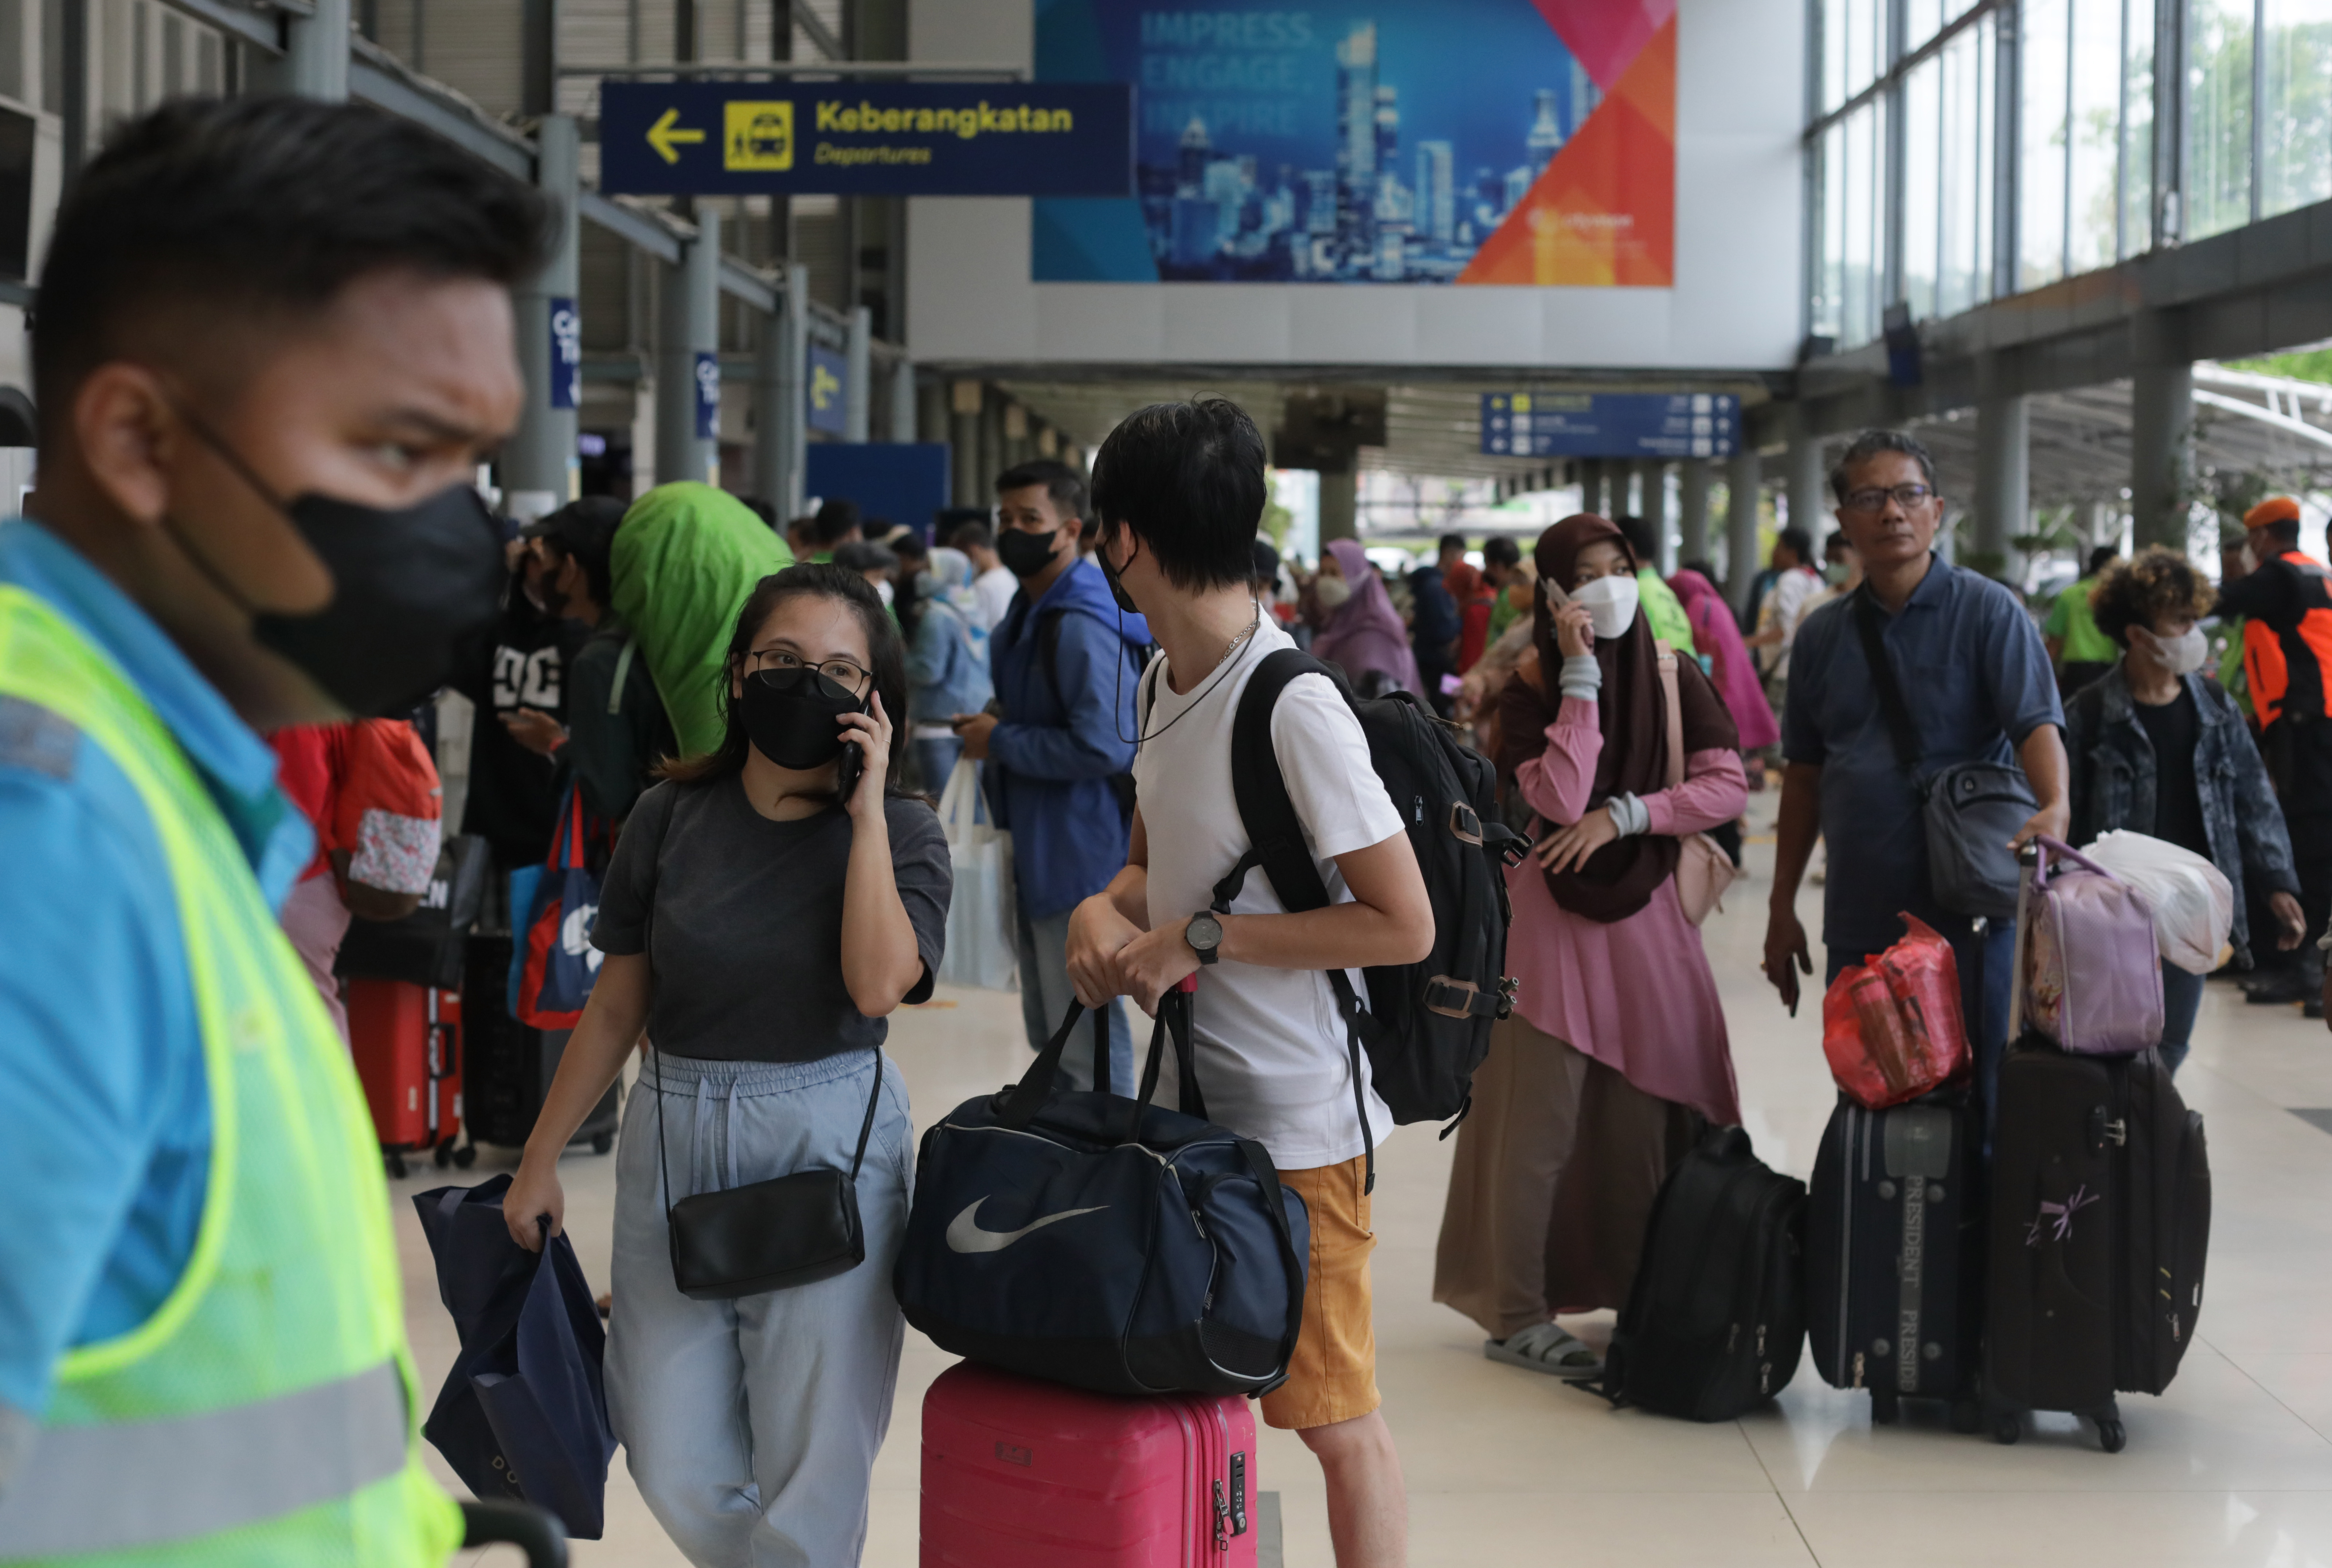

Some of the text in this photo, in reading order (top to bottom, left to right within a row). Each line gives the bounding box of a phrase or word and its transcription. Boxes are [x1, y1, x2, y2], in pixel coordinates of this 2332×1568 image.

[817, 101, 1072, 138] Keberangkatan
[815, 143, 931, 166] Departures
[493, 645, 560, 707] DC
[1903, 1176, 1924, 1288] PRESIDENT
